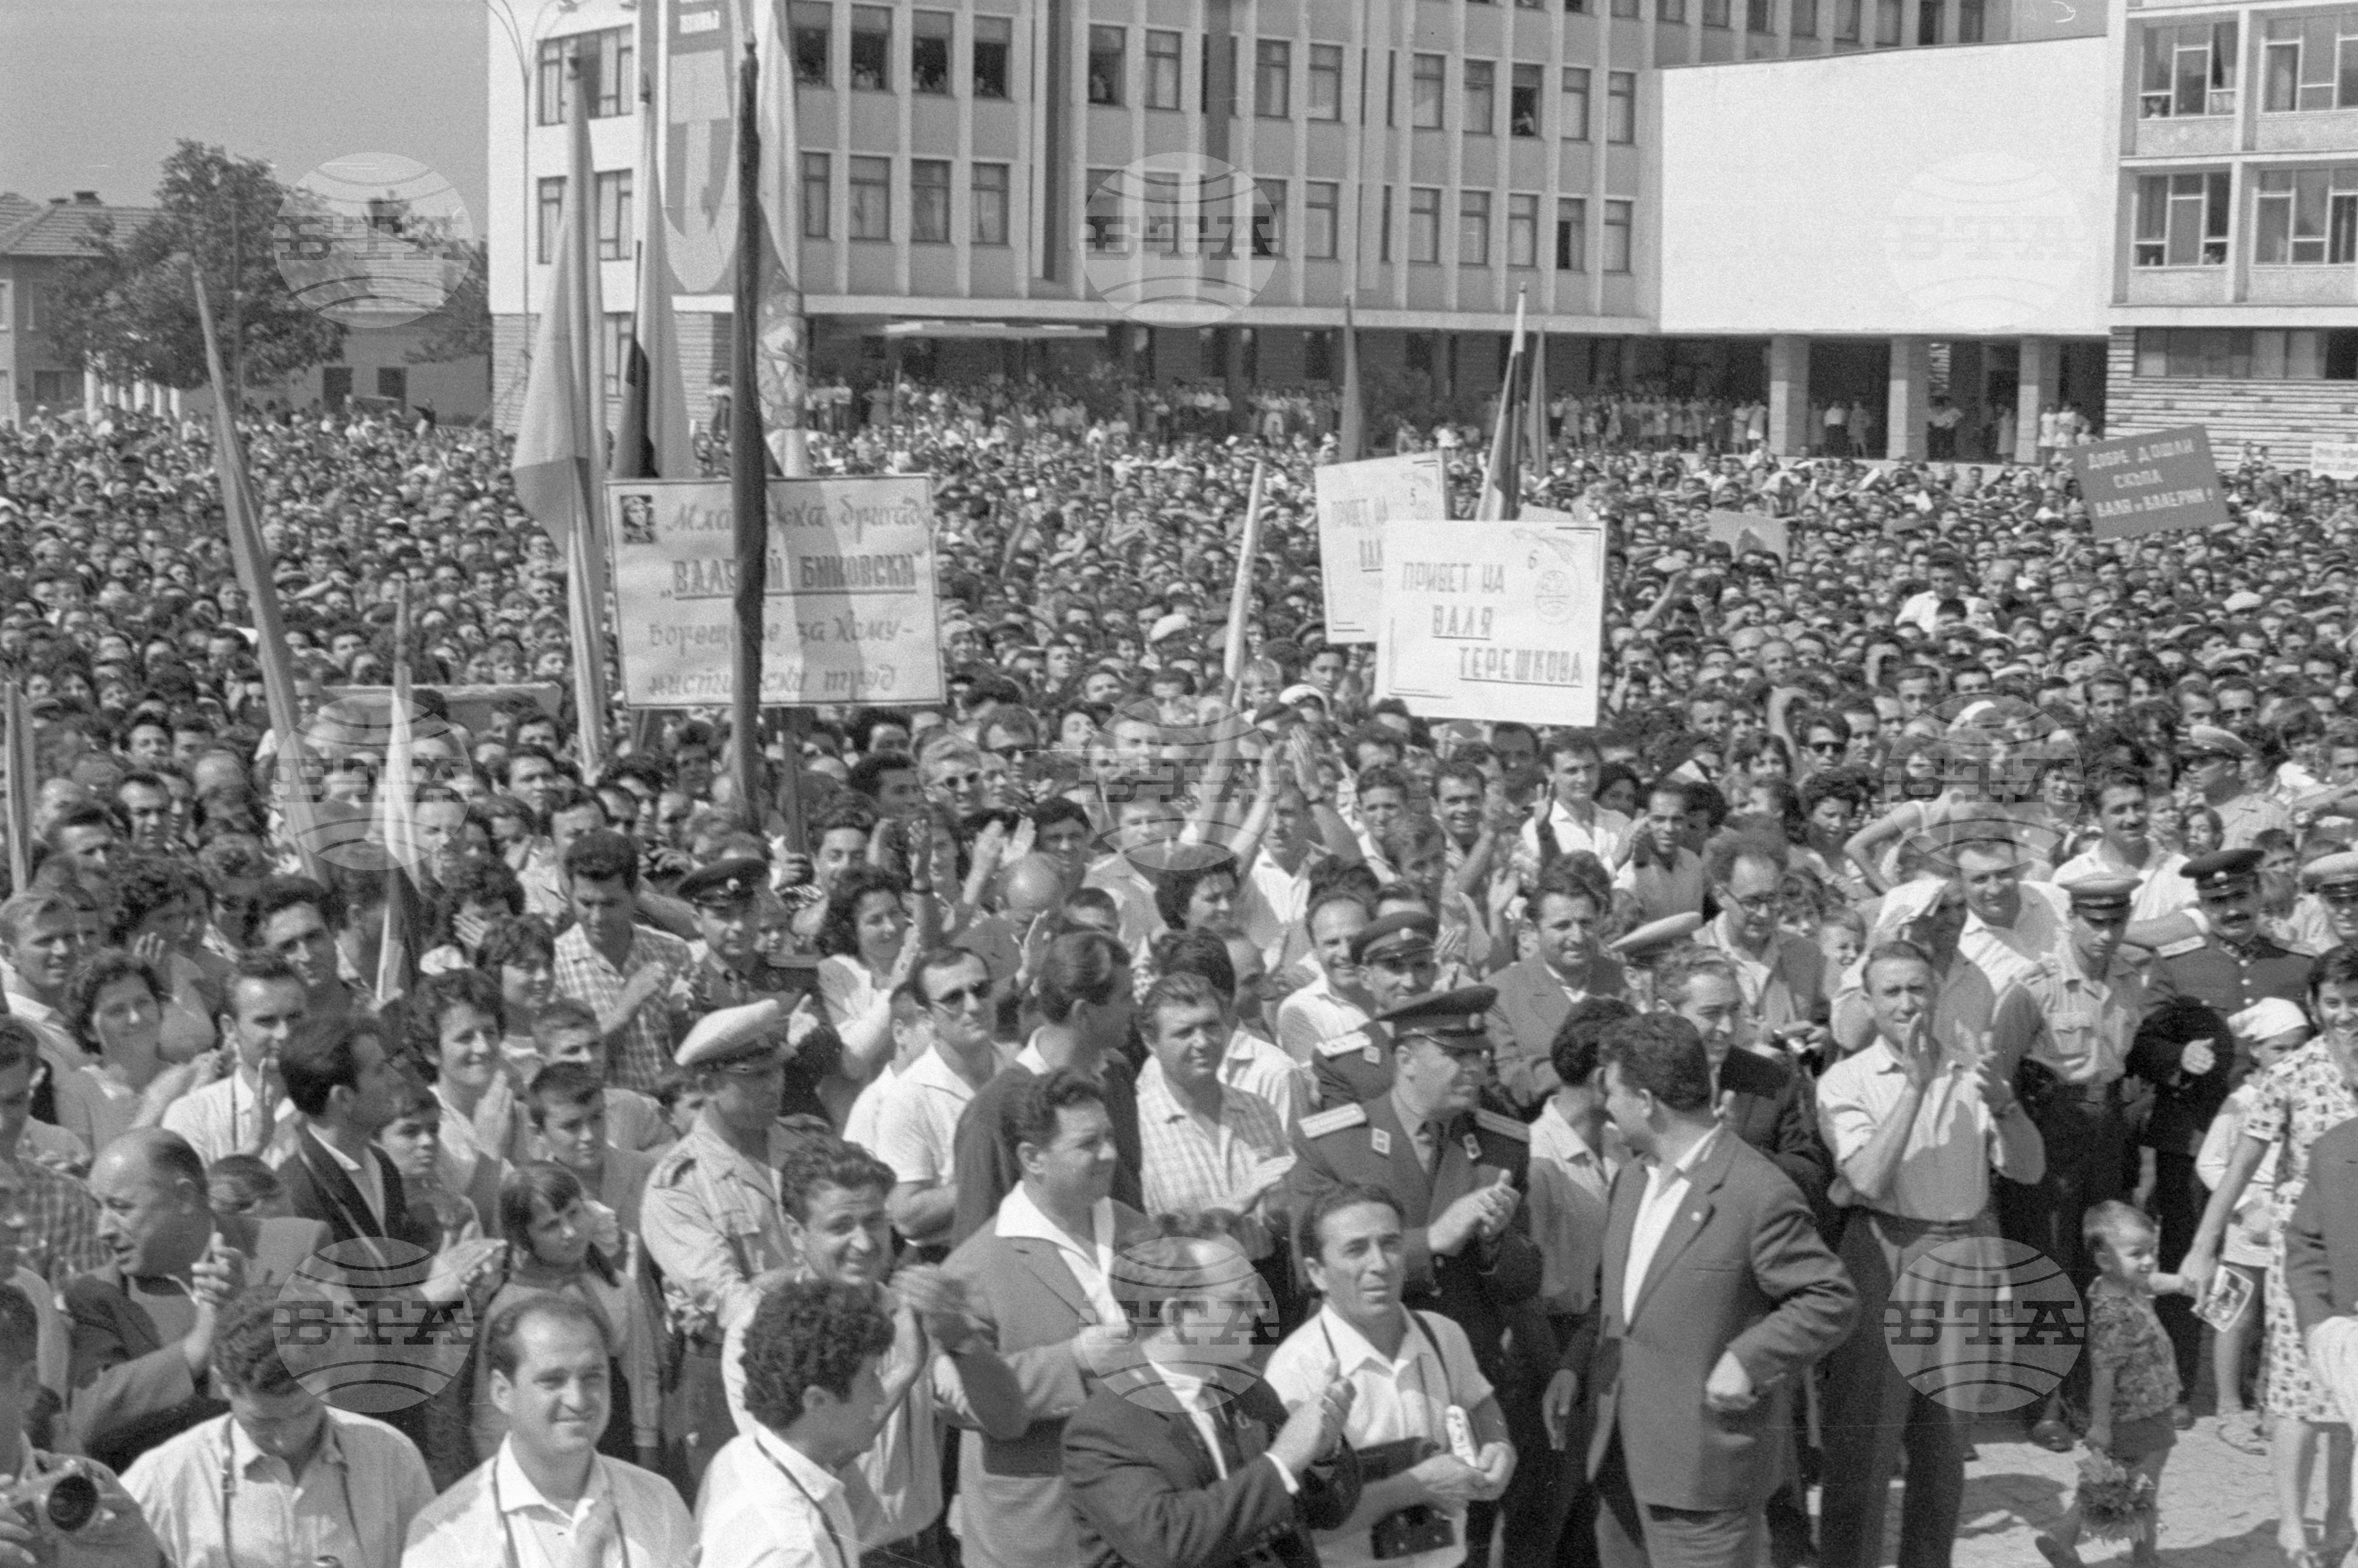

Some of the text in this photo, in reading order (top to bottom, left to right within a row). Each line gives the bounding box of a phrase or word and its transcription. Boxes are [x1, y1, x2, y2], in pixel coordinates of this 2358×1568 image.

[1527, 548, 1539, 570] 6
[1402, 562, 1505, 594] ПРИВЕТ НА
[1432, 604, 1494, 636] ВАЛЯ
[1459, 647, 1583, 682] ТЕРЕШКОВА
